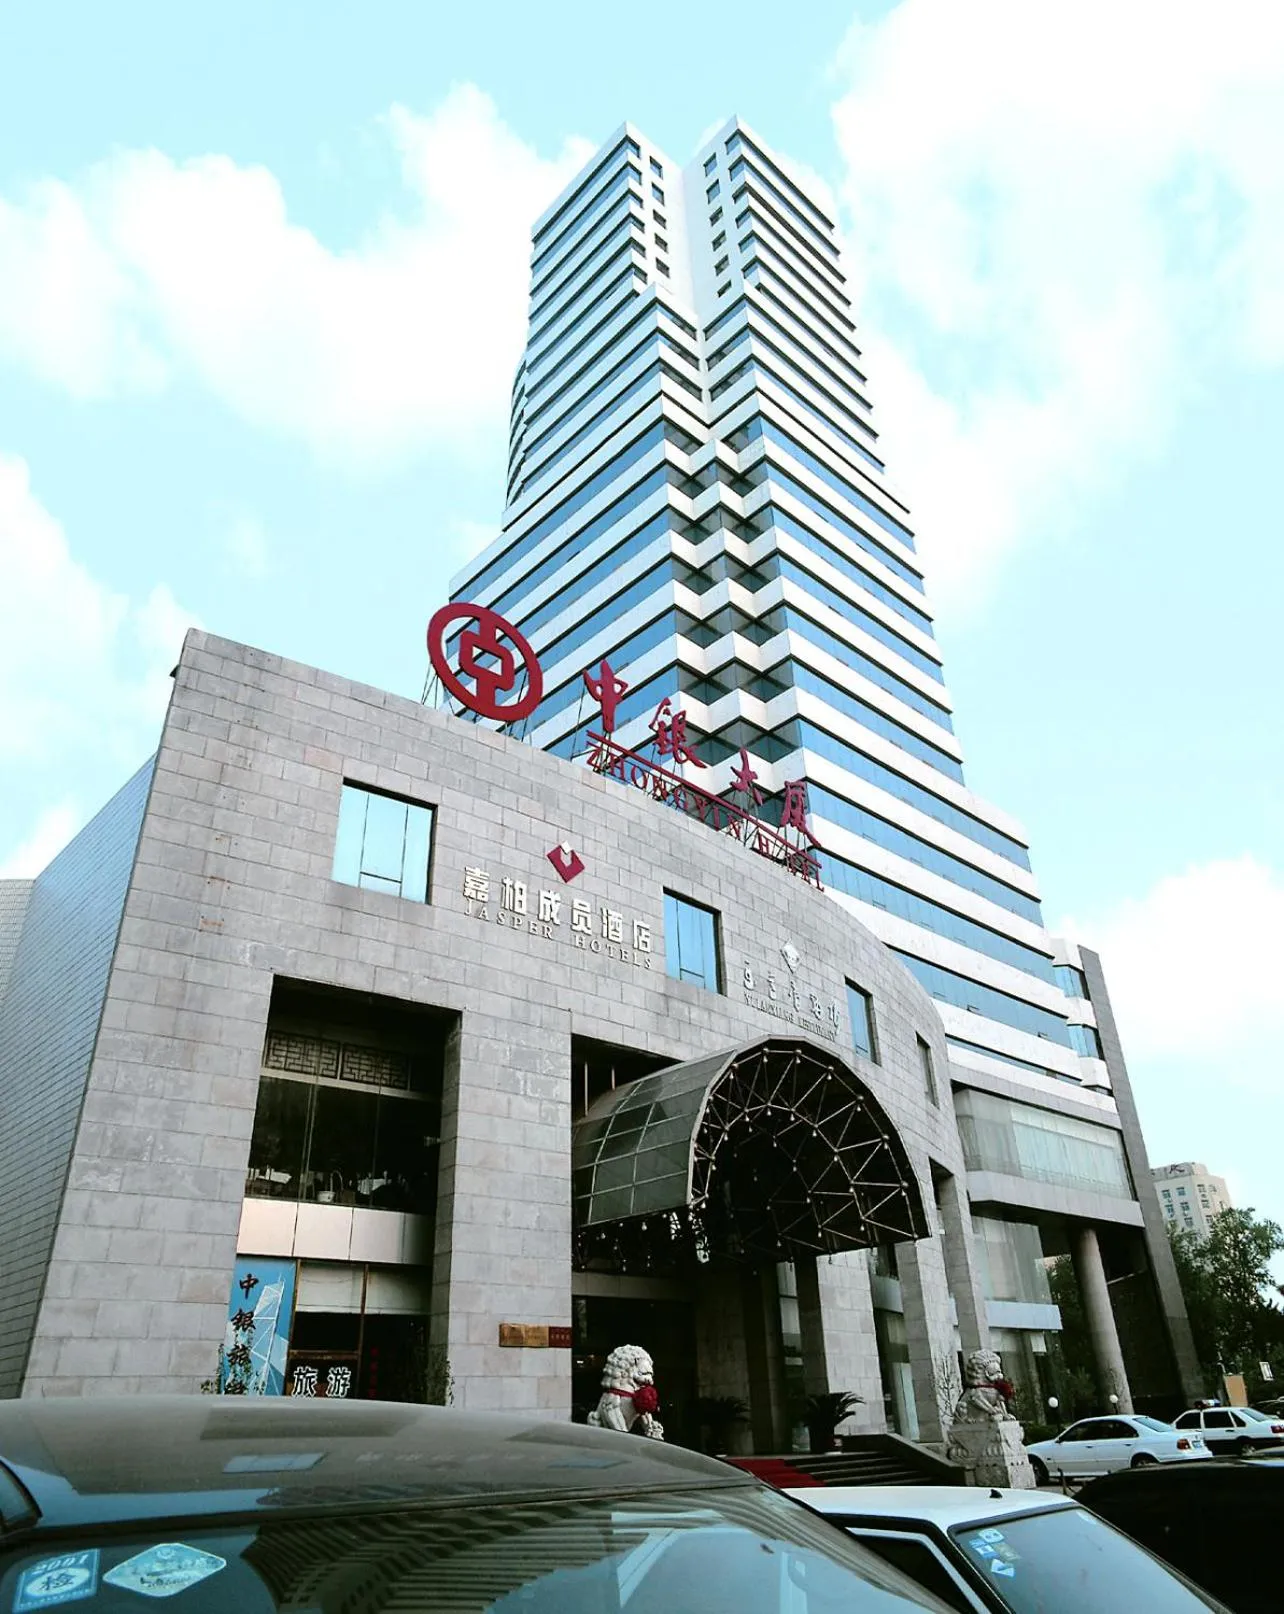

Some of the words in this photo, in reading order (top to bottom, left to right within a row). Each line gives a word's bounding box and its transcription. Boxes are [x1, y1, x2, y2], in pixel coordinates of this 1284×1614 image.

[463, 866, 651, 953] 嘉柏成员酒店
[464, 899, 553, 940] JASPER
[574, 934, 651, 969] HOTELS
[292, 1366, 351, 1398] 旅游
